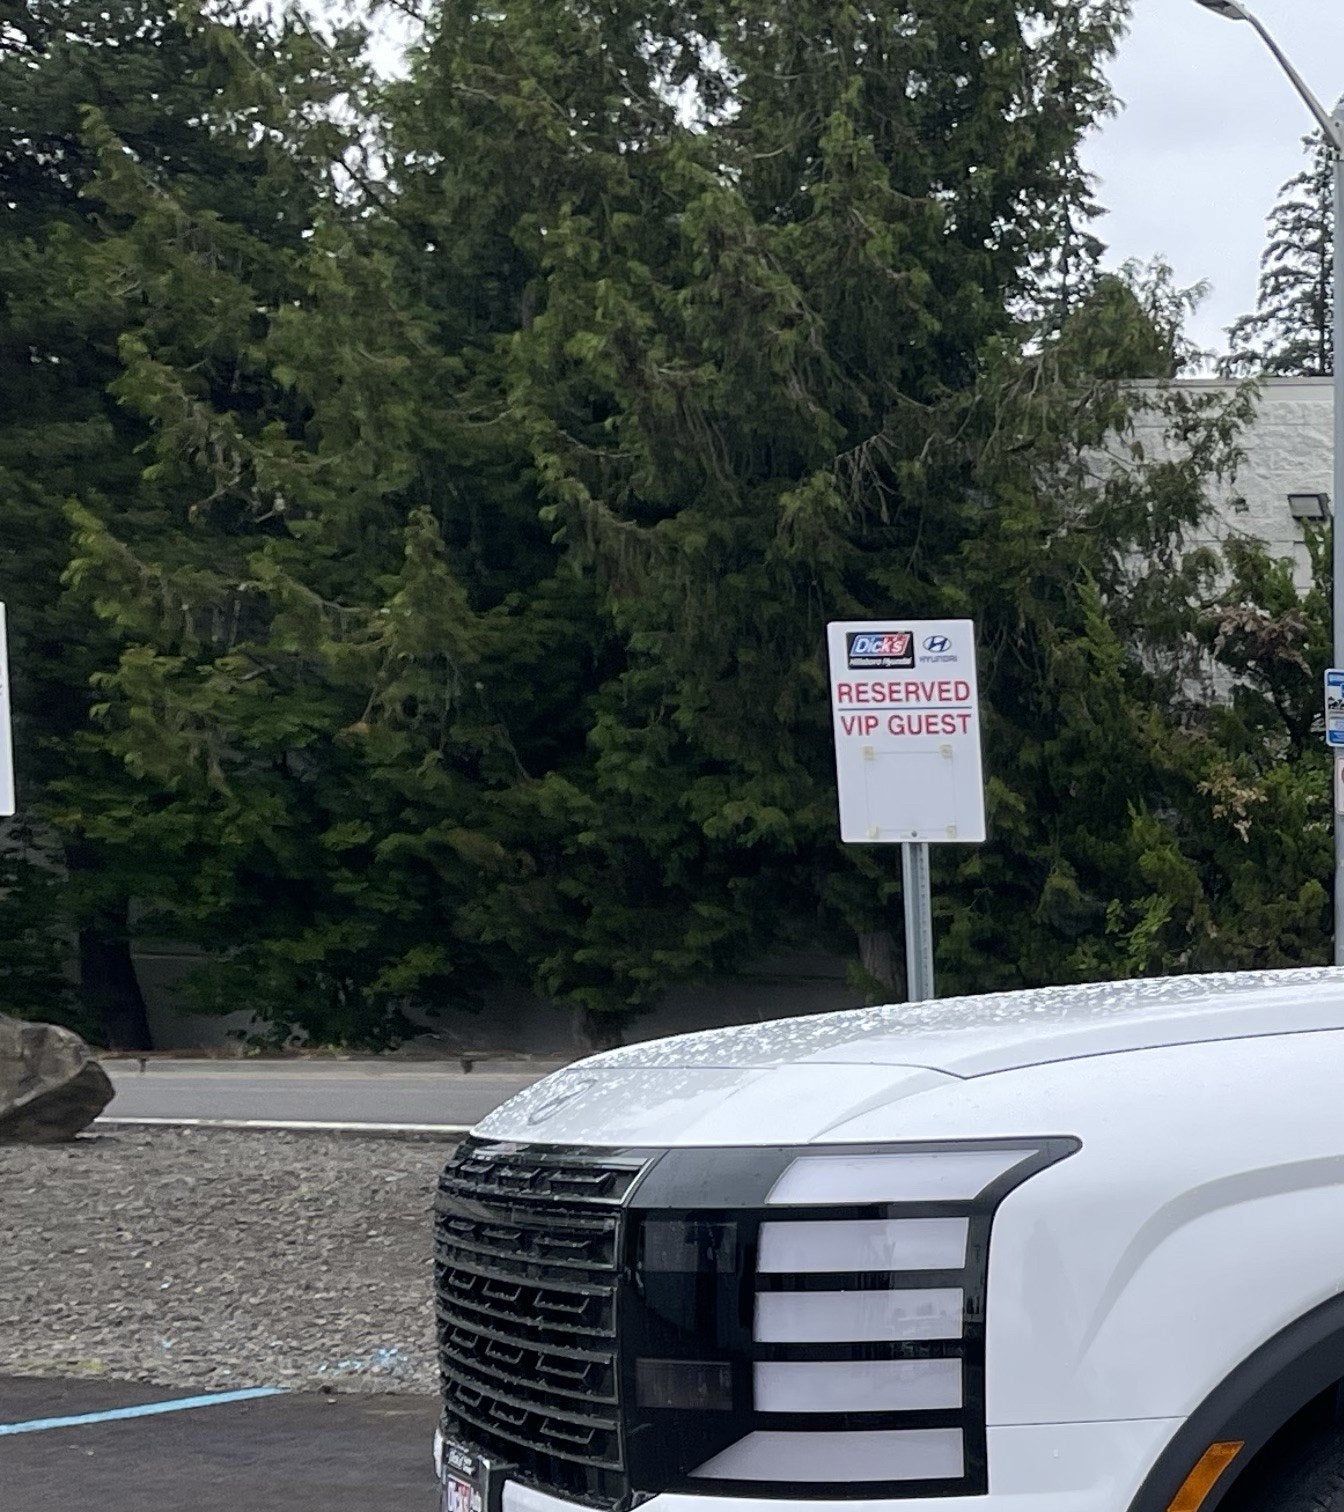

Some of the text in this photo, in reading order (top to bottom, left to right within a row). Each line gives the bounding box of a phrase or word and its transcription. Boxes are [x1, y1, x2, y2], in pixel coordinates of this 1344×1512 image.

[837, 680, 970, 703] RESERVED
[841, 714, 971, 736] VIP GUEST
